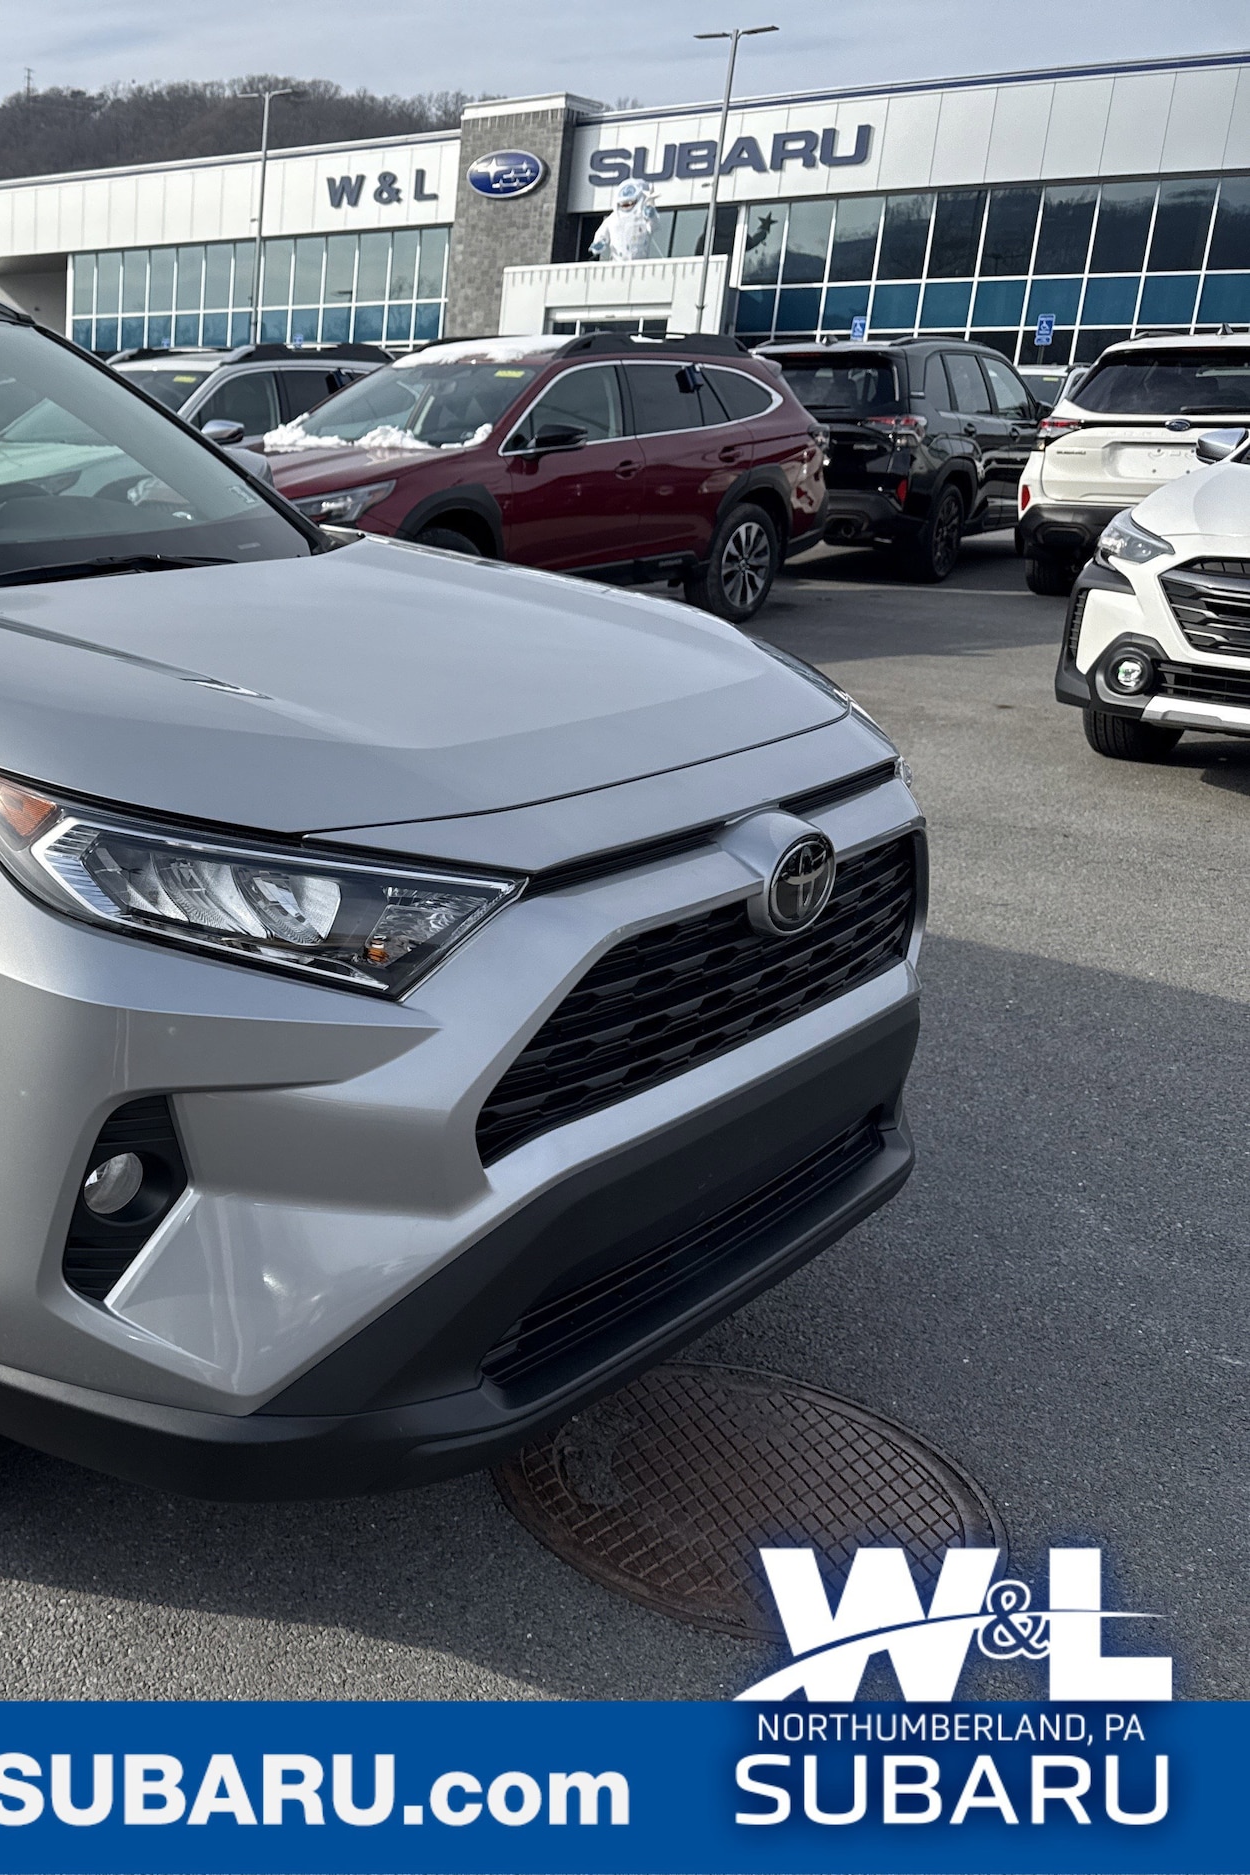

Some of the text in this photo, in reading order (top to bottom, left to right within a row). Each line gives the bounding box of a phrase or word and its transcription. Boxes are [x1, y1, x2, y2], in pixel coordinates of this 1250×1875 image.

[588, 124, 874, 187] SUBARU
[326, 168, 439, 209] W & L
